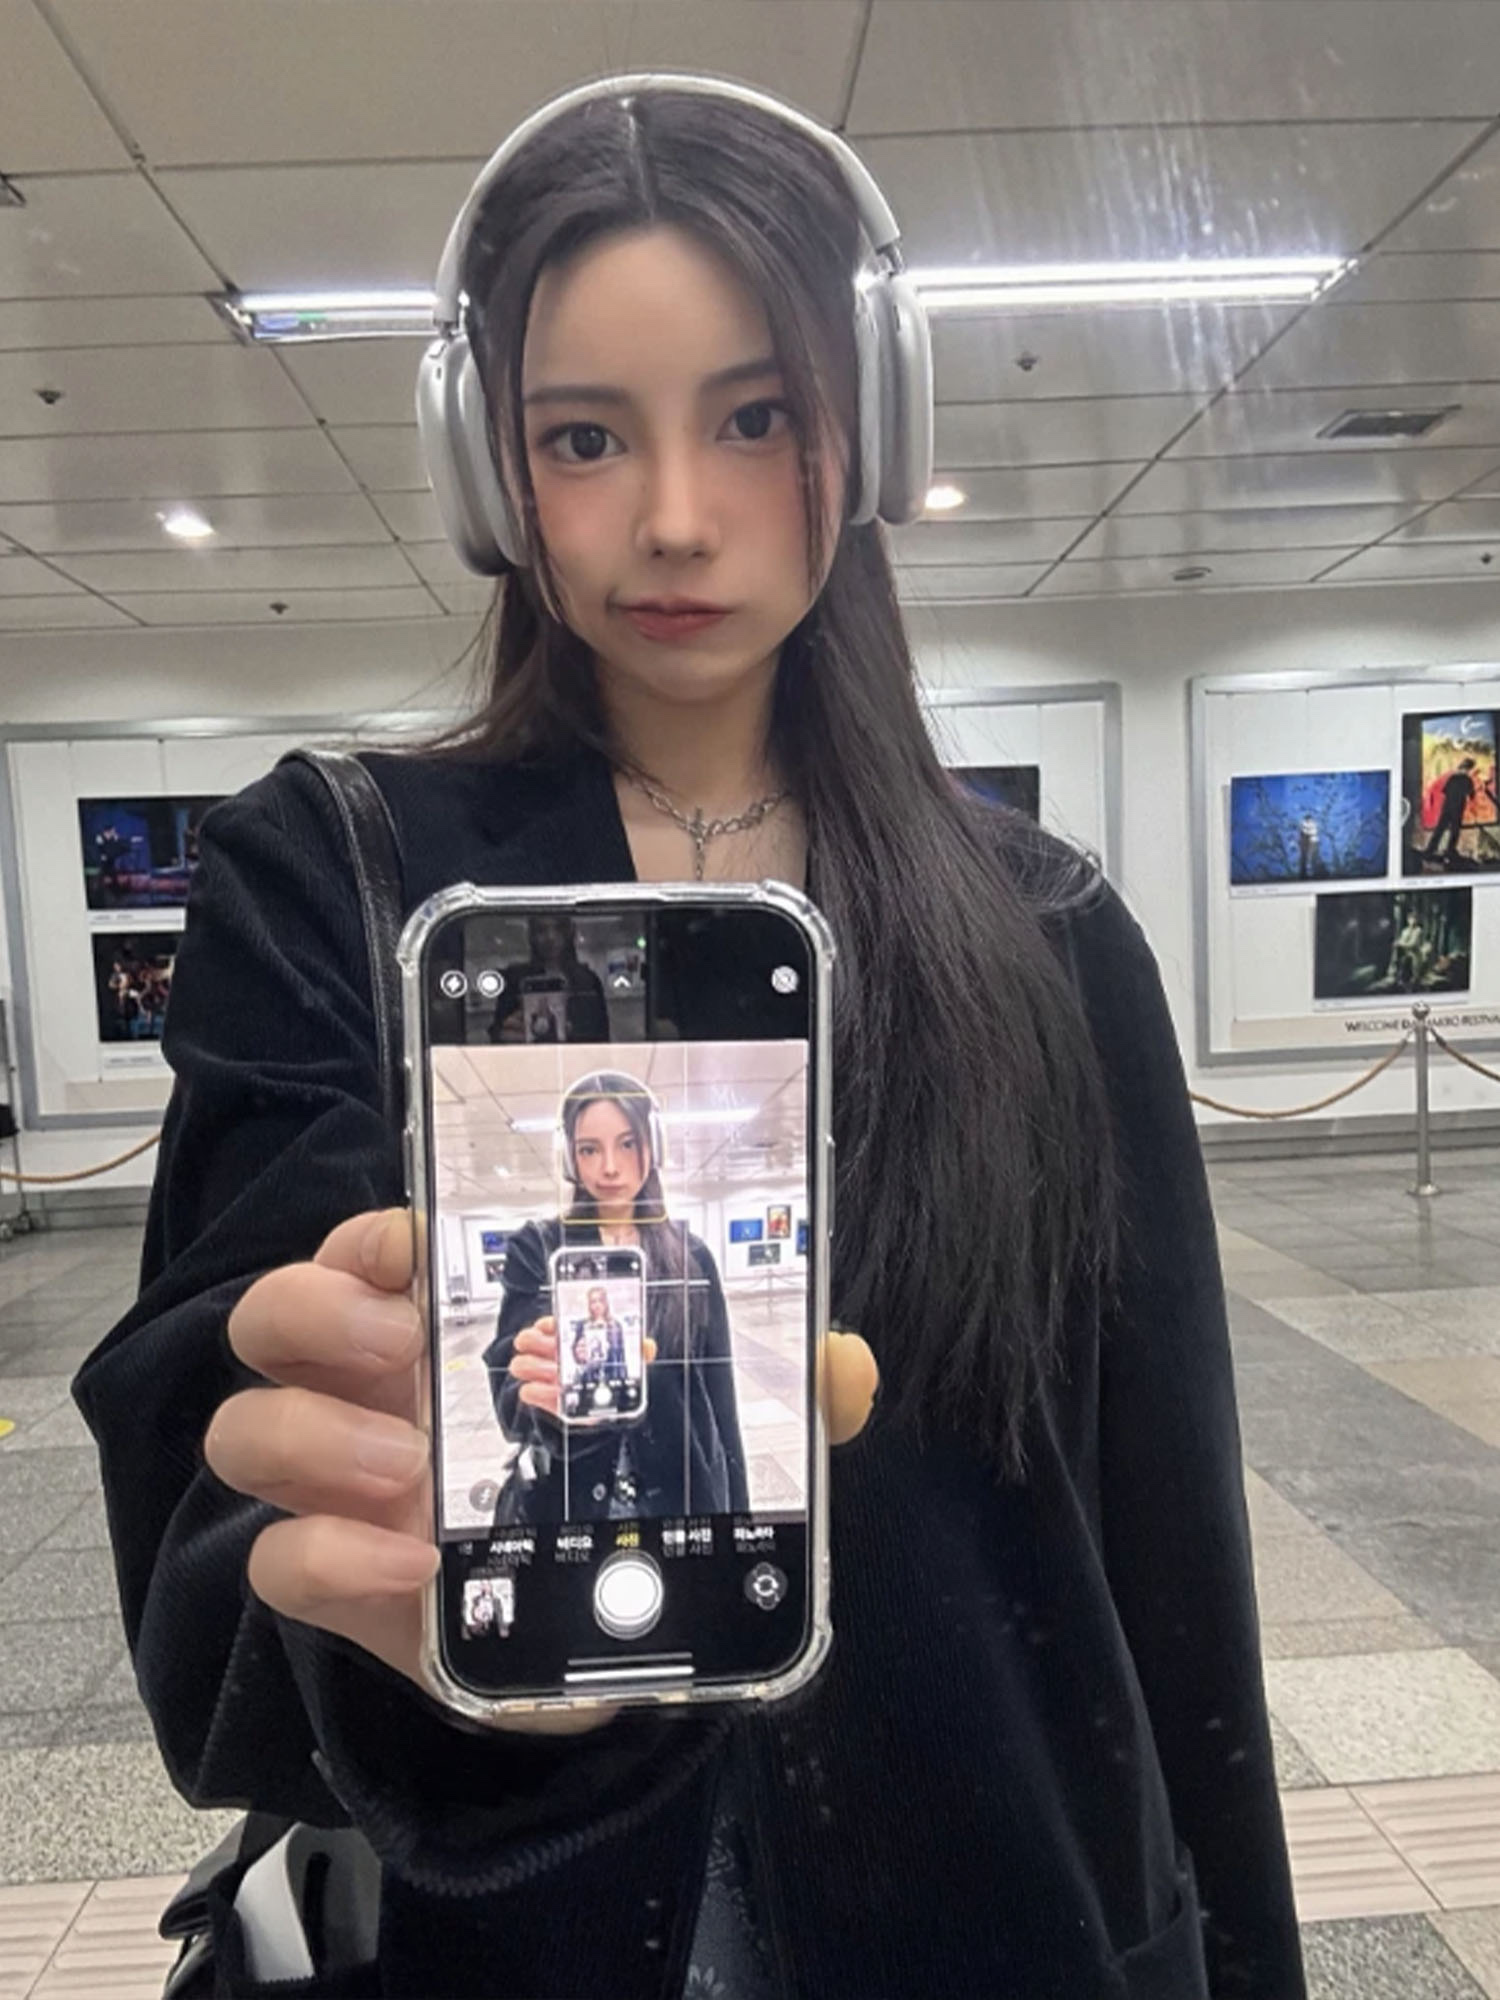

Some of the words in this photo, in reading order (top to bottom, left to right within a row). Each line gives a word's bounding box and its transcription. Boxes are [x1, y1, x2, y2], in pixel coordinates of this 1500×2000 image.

[1344, 1019, 1398, 1032] WELCOME
[556, 1535, 593, 1549] 비디오
[615, 1532, 639, 1548] 사진
[688, 1527, 712, 1543] 사진
